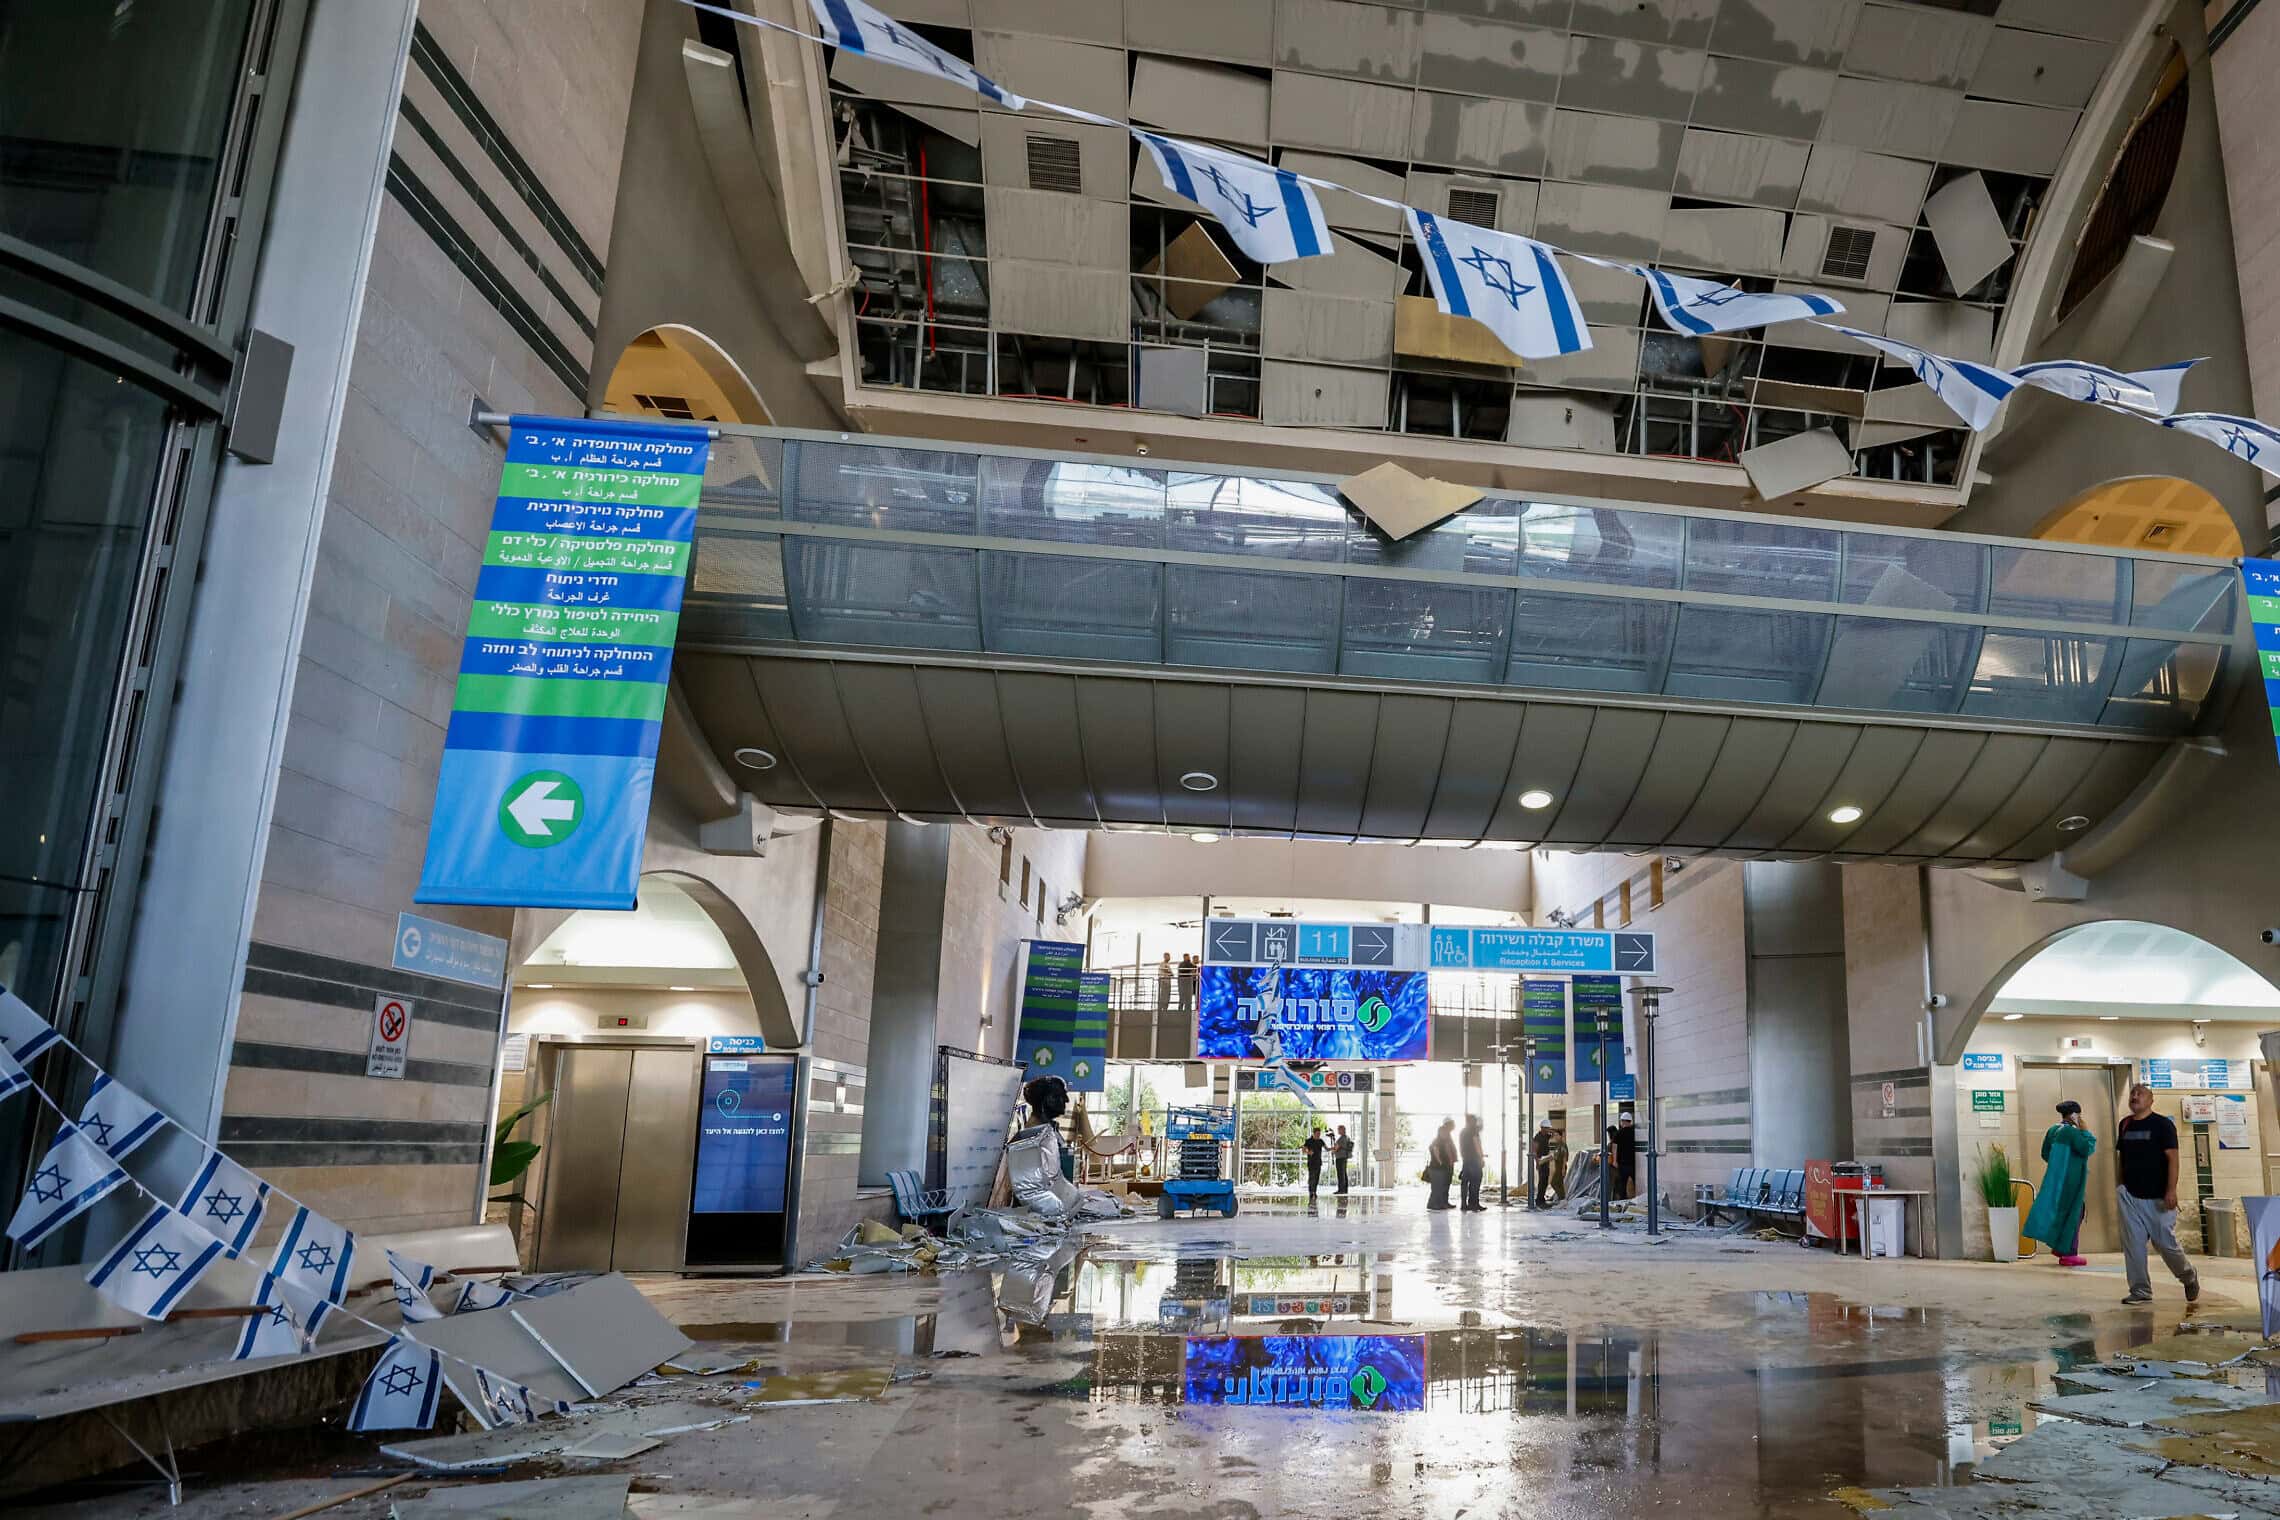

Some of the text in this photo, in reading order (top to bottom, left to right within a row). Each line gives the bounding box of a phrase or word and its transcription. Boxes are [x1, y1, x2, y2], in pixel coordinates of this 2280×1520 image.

[573, 439, 642, 451] אורתופדיה
[644, 443, 693, 455] מחלקת
[611, 454, 640, 468] جراحة
[643, 458, 662, 469] قسم
[572, 471, 629, 483] כירורגית
[632, 474, 680, 487] מחלקה
[587, 487, 615, 500] جراحة
[619, 490, 638, 500] قسم
[527, 502, 664, 519] מחלקה נוירוכירורגית
[590, 520, 618, 533] جراحة
[622, 523, 640, 535] قسم
[502, 536, 522, 545] דם
[526, 534, 547, 547] כלי
[560, 538, 622, 552] פלסטיקה
[625, 541, 676, 555] מחלקת
[620, 556, 649, 570] جراحة
[652, 560, 672, 572] قسم
[546, 574, 618, 585] חדרי ניתוח
[547, 588, 583, 603] الجراحة
[491, 603, 659, 623] היחידה לטיפול נמרץ כללי
[482, 643, 653, 661] המחלקה לניתוחי לב וחזה
[508, 662, 623, 678] قسم جراحة القلب والصدر
[1312, 931, 1337, 952] 11
[1480, 934, 1604, 948] משרד קבלה ושירות
[1500, 957, 1541, 967] Reception
[1551, 959, 1585, 967] Services
[1237, 997, 1355, 1022] סורוה
[1264, 1074, 1276, 1085] 12
